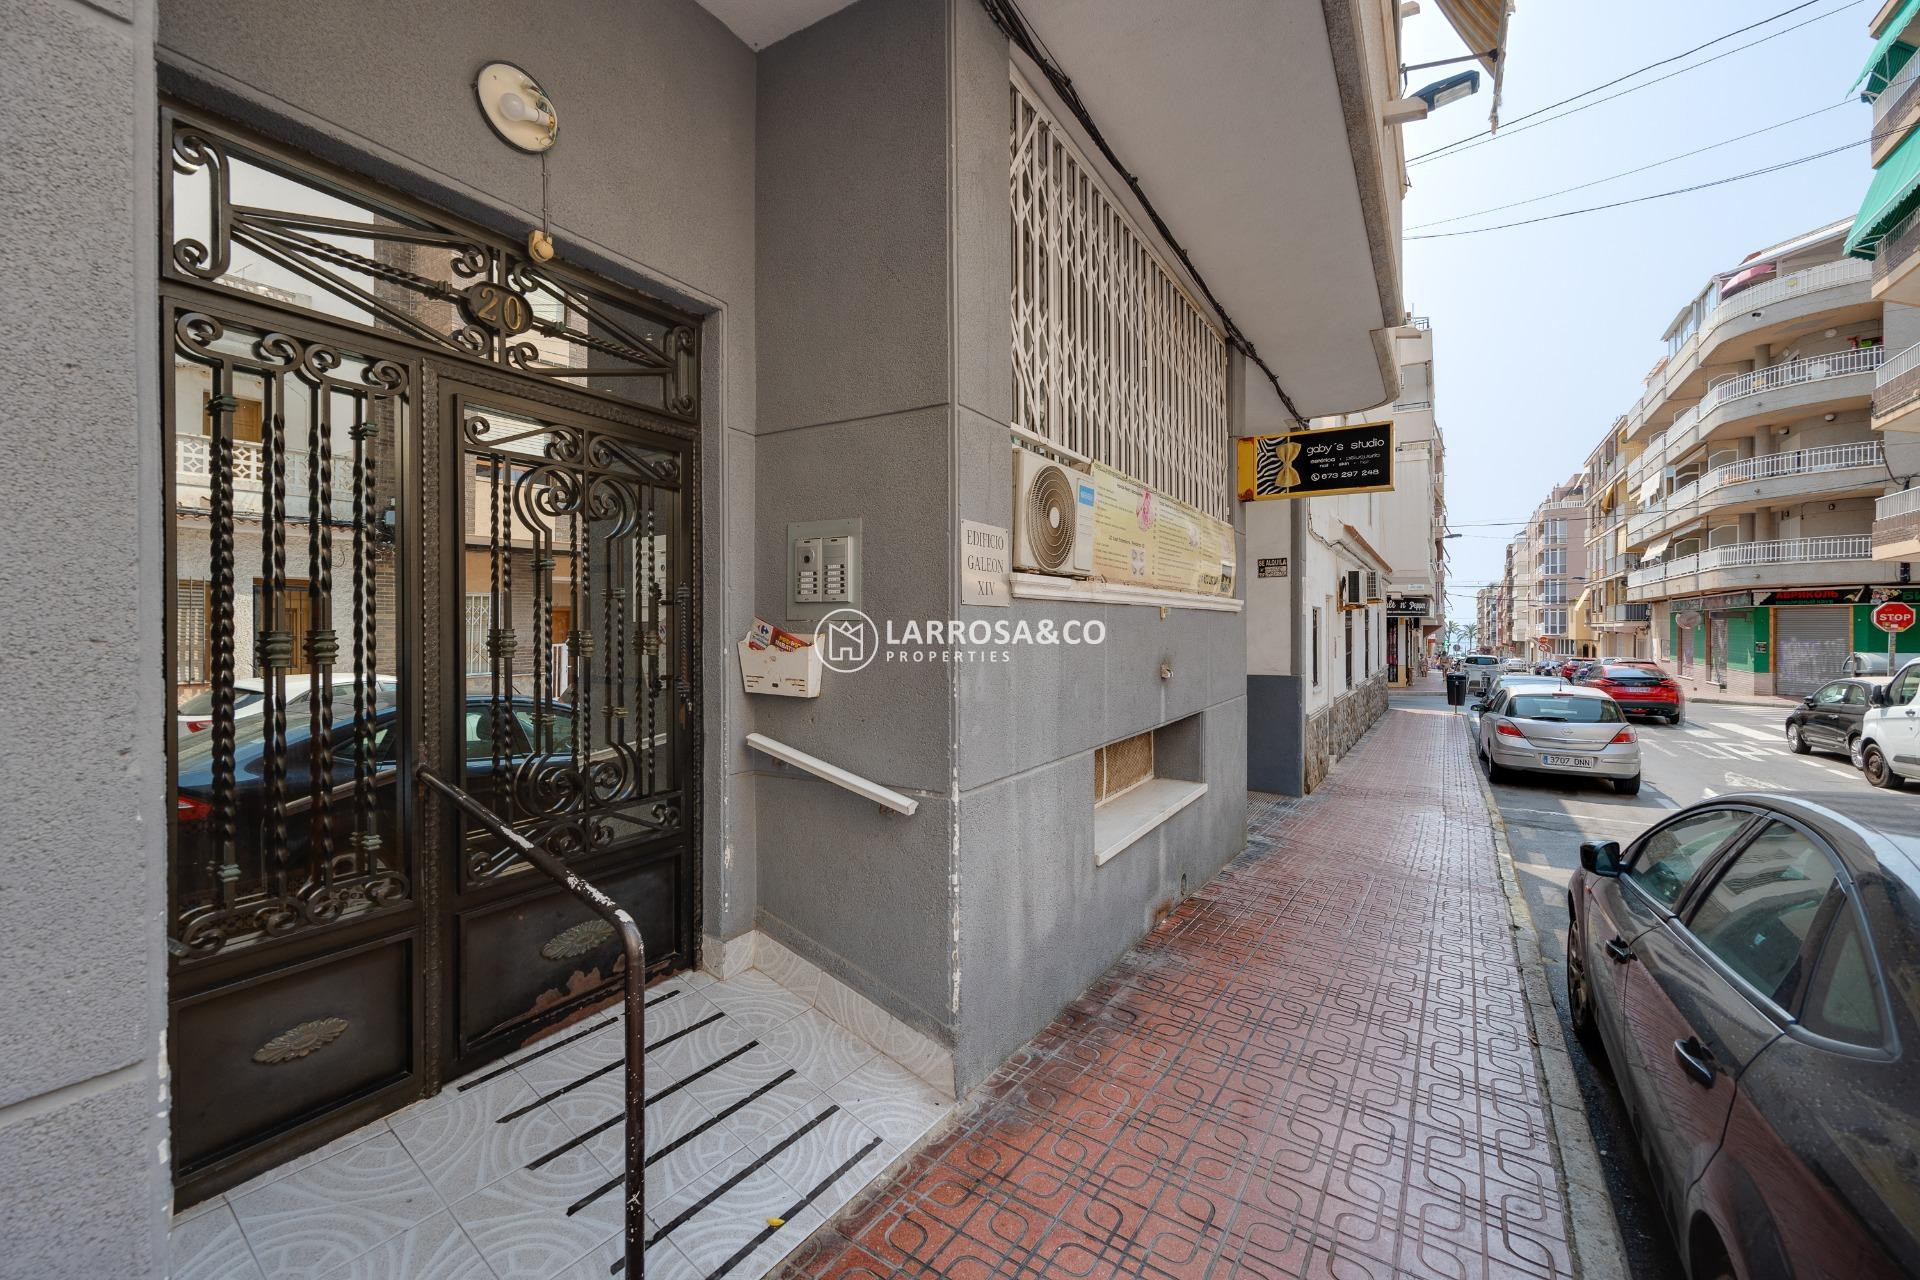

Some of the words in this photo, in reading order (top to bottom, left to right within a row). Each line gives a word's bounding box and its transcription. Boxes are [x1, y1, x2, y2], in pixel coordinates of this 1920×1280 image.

[478, 287, 521, 330] 20
[1350, 437, 1385, 450] studio
[1321, 472, 1339, 480] 673
[1341, 470, 1359, 478] 297
[1361, 468, 1380, 477] 248
[967, 529, 1004, 551] EDIFICIO
[967, 554, 1004, 574] GALEON
[977, 580, 996, 596] XIV
[1879, 613, 1911, 621] STOP
[1550, 756, 1570, 765] 3707
